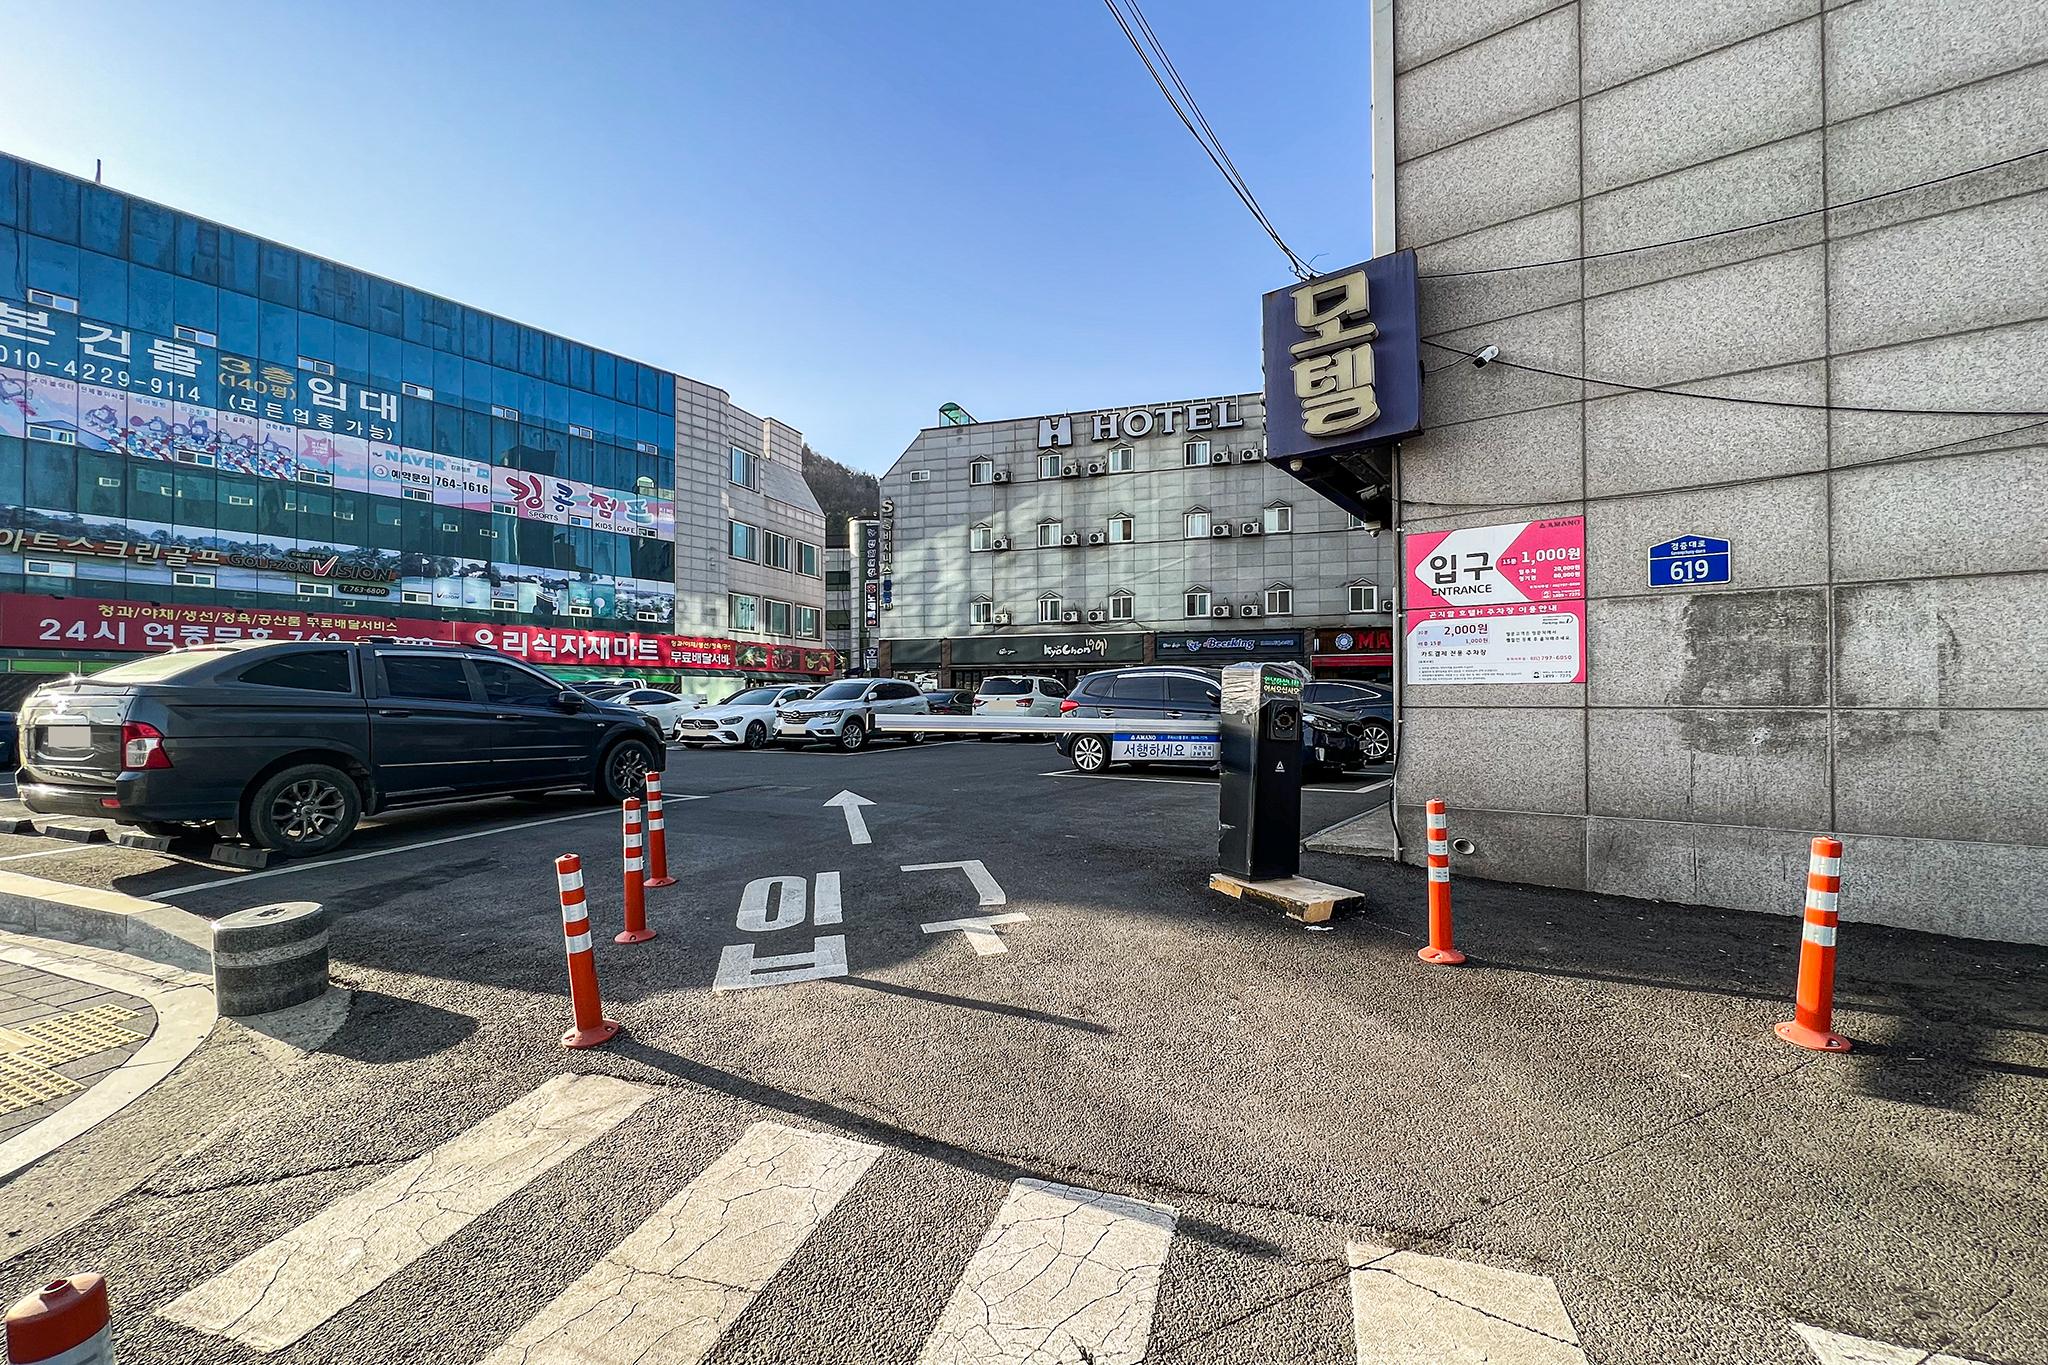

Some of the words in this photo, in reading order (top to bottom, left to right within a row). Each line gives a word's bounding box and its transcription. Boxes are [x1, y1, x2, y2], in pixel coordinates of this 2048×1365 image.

[76, 322, 202, 378] 건물
[0, 345, 200, 402] 010-4229-9114
[220, 356, 296, 386] 3층
[218, 372, 297, 401] (140평)
[307, 377, 397, 423] 임대
[228, 394, 285, 419] (모든
[292, 407, 335, 429] 업종
[346, 420, 393, 441] 가능)
[1091, 400, 1244, 442] HOTEL
[385, 450, 447, 471] NAVER
[391, 469, 431, 485] 예약문의
[434, 476, 489, 494] 764-1616
[505, 474, 655, 525] 킹콩점프
[528, 510, 559, 522] SPORTS
[1548, 519, 1580, 528] AMANO
[595, 522, 613, 531] KIDS
[616, 525, 636, 534] CAFE
[0, 528, 221, 568] 아트스크린골프
[1521, 547, 1581, 565] 1,000원
[1671, 540, 1706, 551] 경충대로
[312, 555, 392, 582] VISION
[1430, 552, 1494, 584] 입구
[1670, 559, 1709, 581] 619
[341, 585, 386, 596] T.763-6800
[1431, 584, 1492, 597] ENTRANCE
[1486, 606, 1514, 616] 주차장
[1518, 604, 1558, 613] 이용안내
[39, 618, 126, 645] 24시
[306, 616, 398, 632] 무료배달서비스
[1444, 623, 1488, 637] 2,000원
[1465, 637, 1489, 645] 1,000원
[1465, 649, 1487, 657] 주차장
[1123, 743, 1185, 757] 서행하세요
